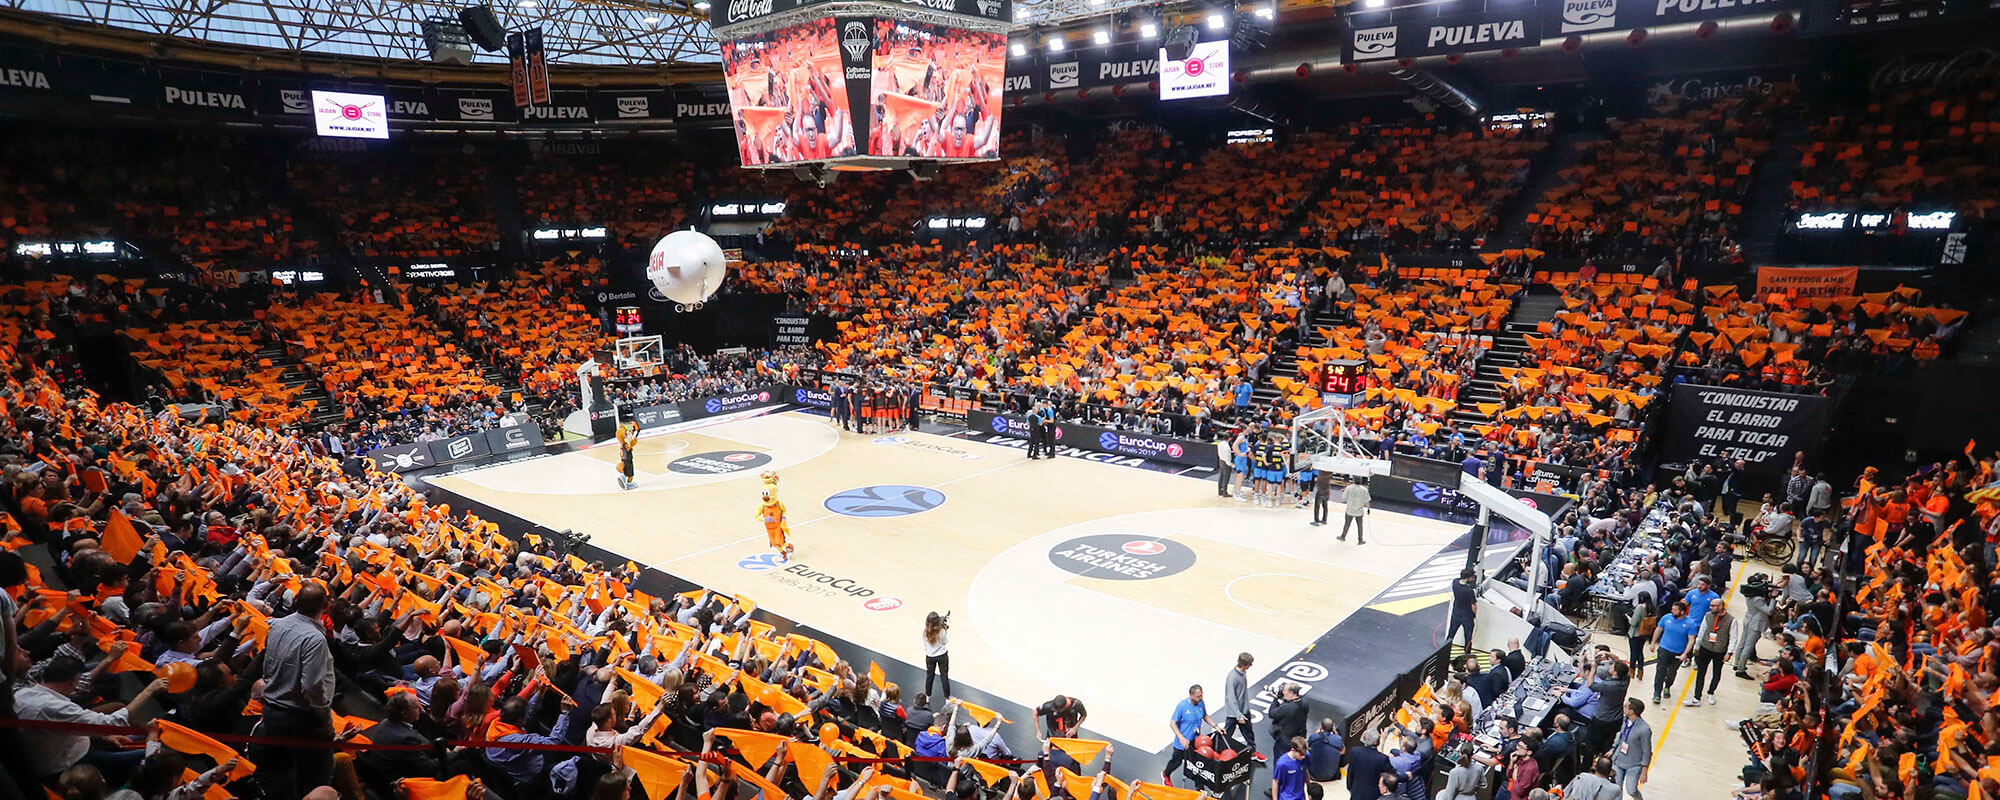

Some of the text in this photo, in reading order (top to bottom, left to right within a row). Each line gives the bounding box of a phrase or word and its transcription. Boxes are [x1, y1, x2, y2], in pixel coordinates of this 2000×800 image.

[1357, 31, 1394, 42] PULEVA
[1427, 20, 1525, 48] PULEVA
[1052, 65, 1078, 75] PULEVA
[1100, 60, 1160, 80] PULEVA
[164, 86, 246, 109] PULEVA
[618, 98, 648, 108] PULEVA
[461, 100, 492, 109] PULEVA
[524, 105, 588, 119] PULEVA
[1451, 259, 1462, 267] 110
[1623, 264, 1635, 272] 109
[627, 314, 641, 325] 24
[779, 326, 786, 334] EL
[776, 335, 791, 343] PARA
[1325, 375, 1350, 393] 24
[722, 393, 758, 405] EuroCup
[738, 402, 752, 410] 2019
[1706, 410, 1782, 428] EL BARRO
[1119, 434, 1167, 452] EuroCup
[1695, 426, 1789, 447] PARA TOCAR
[1119, 445, 1157, 457] Finals 2019
[1699, 444, 1718, 457] EL
[1055, 549, 1153, 579] AIRLINES
[1074, 543, 1167, 573] TURKISH
[764, 571, 837, 598] Finals 2019
[785, 563, 875, 598] EuroCup
